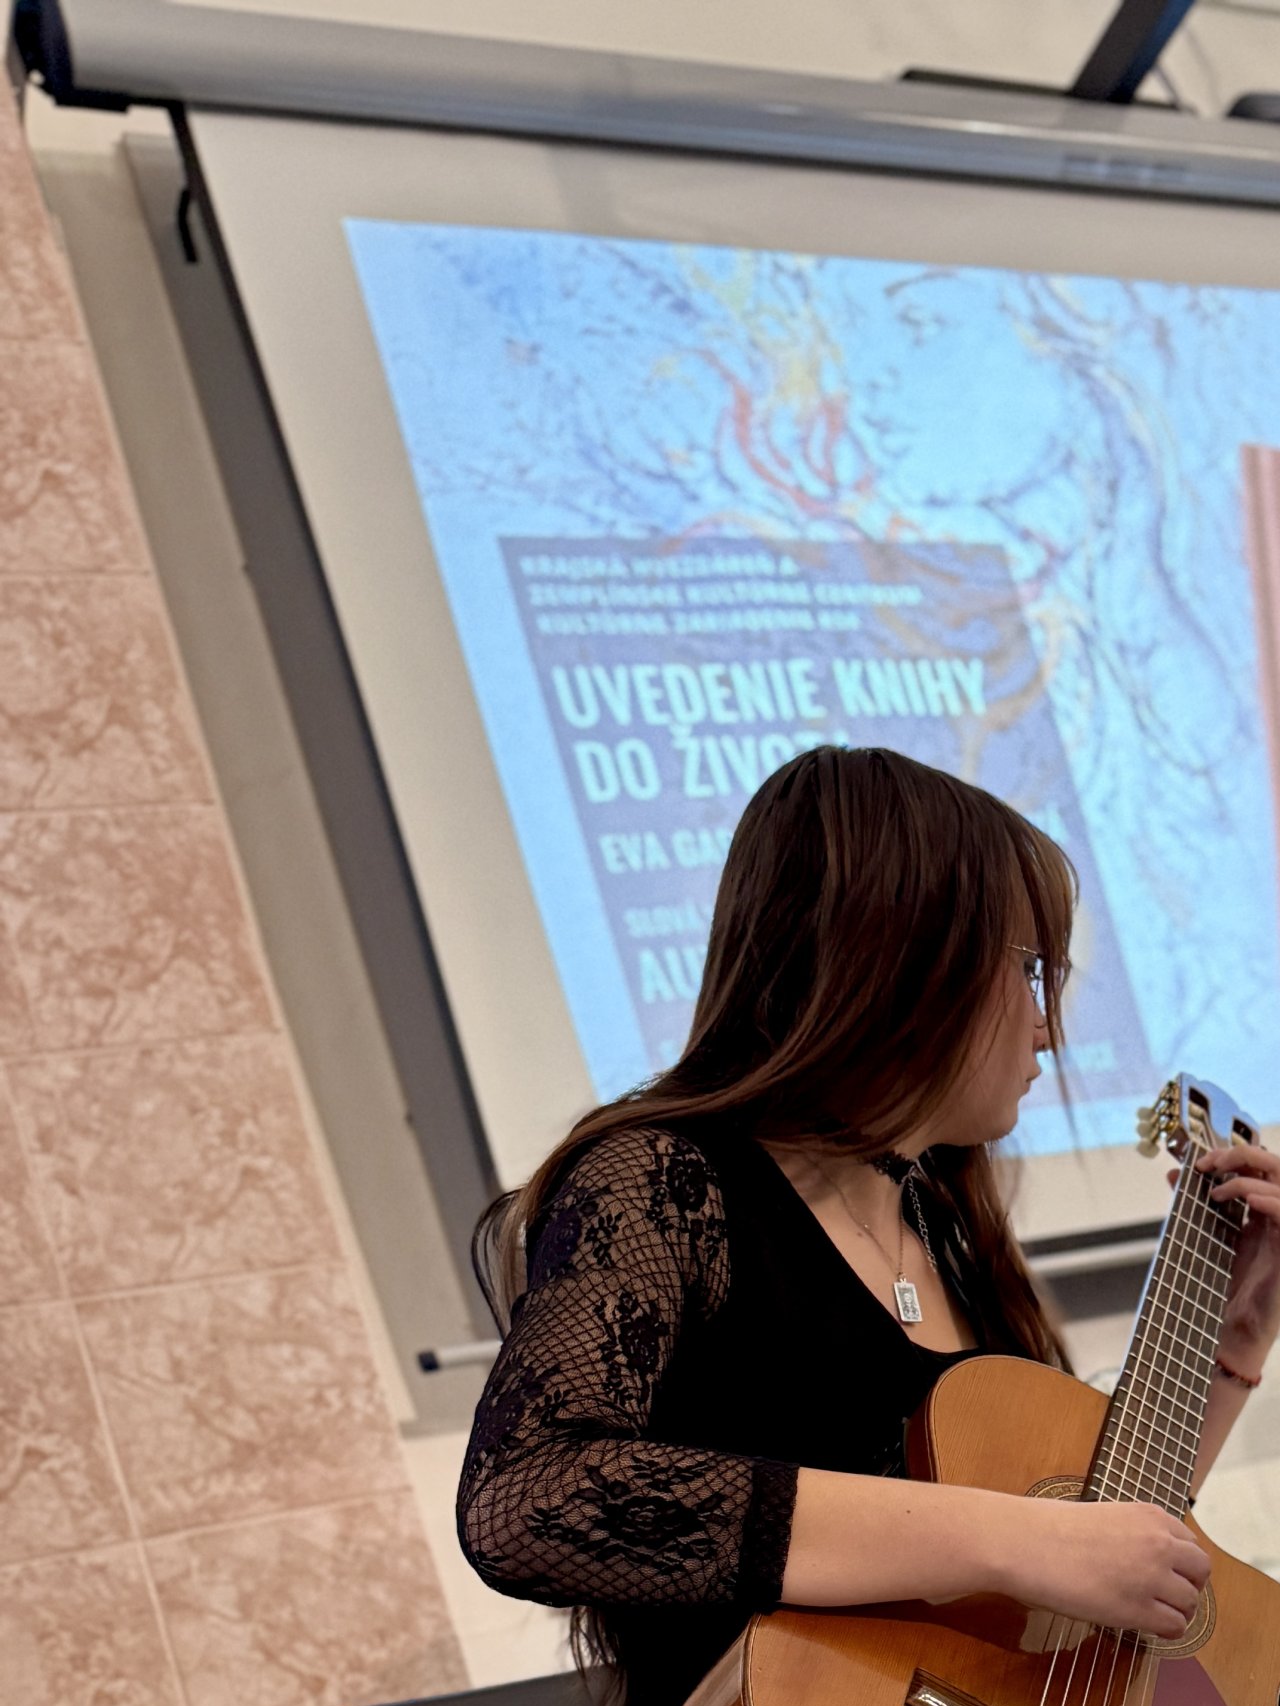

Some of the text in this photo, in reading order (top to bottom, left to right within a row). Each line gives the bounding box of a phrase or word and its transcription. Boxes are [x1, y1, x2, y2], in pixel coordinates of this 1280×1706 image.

[551, 656, 987, 729] UVEDENIE KNIHY
[573, 738, 662, 803] DO
[598, 829, 672, 874] EVA
